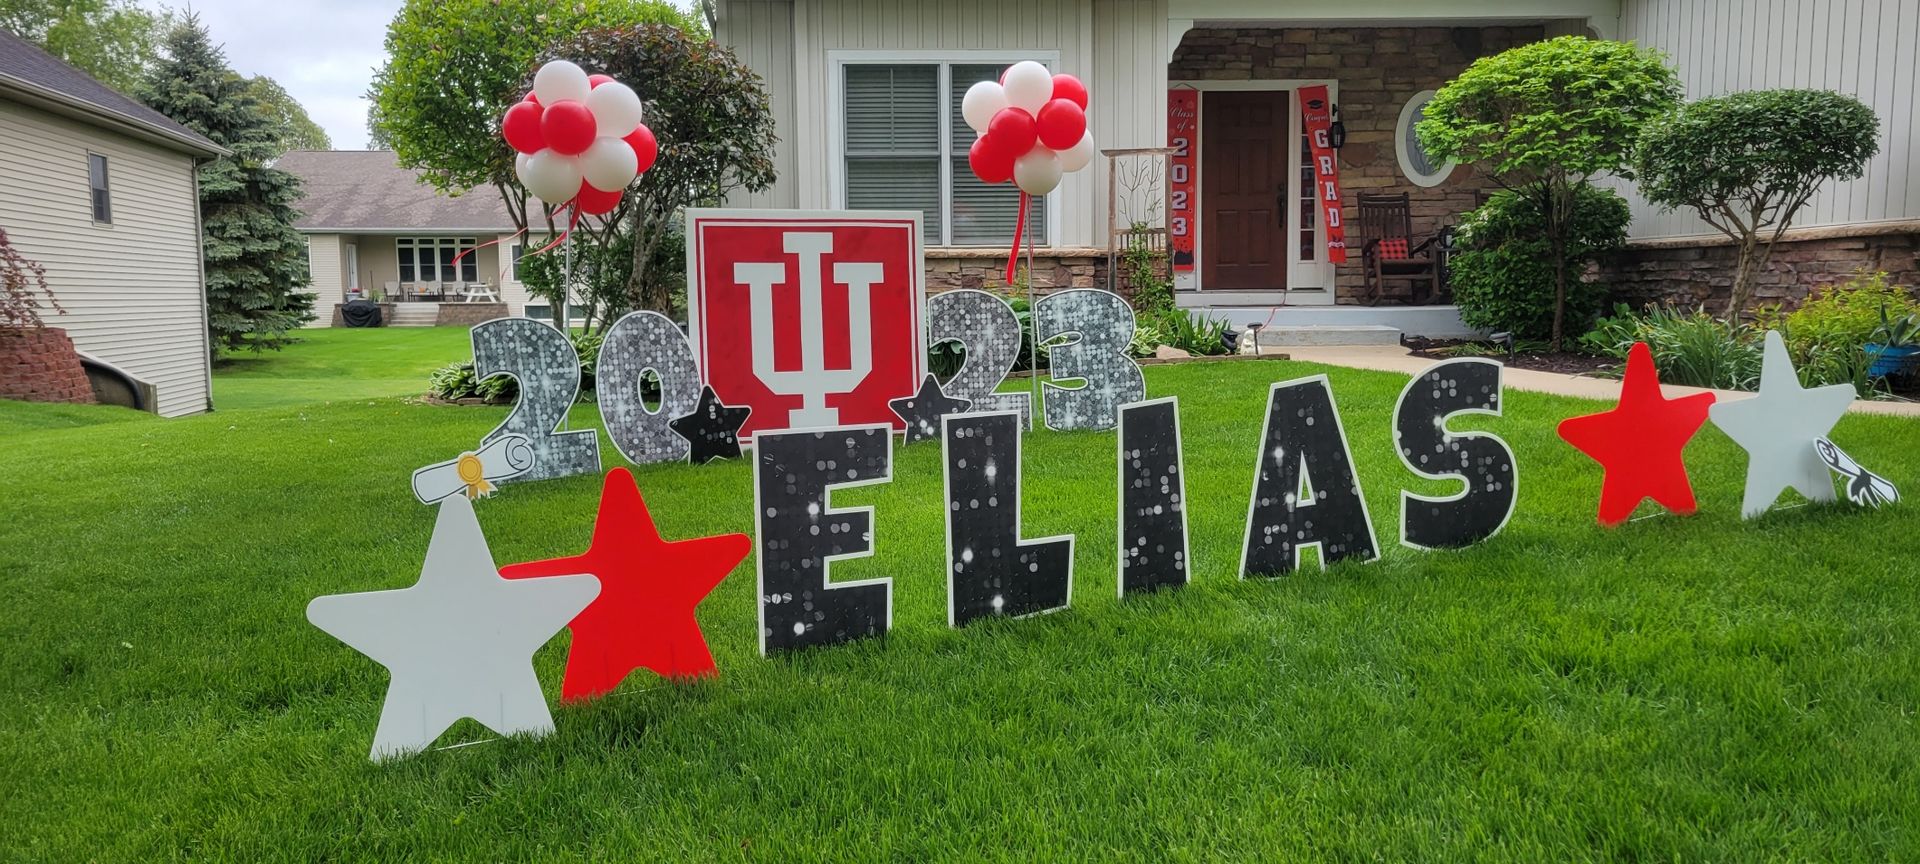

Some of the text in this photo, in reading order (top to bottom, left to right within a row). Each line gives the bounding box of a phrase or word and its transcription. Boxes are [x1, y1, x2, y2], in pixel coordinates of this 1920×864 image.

[1169, 105, 1194, 118] Class
[1176, 118, 1187, 133] of
[1171, 137, 1188, 236] 2023
[1314, 129, 1339, 228] GRAD
[753, 357, 1519, 657] ELIAS
